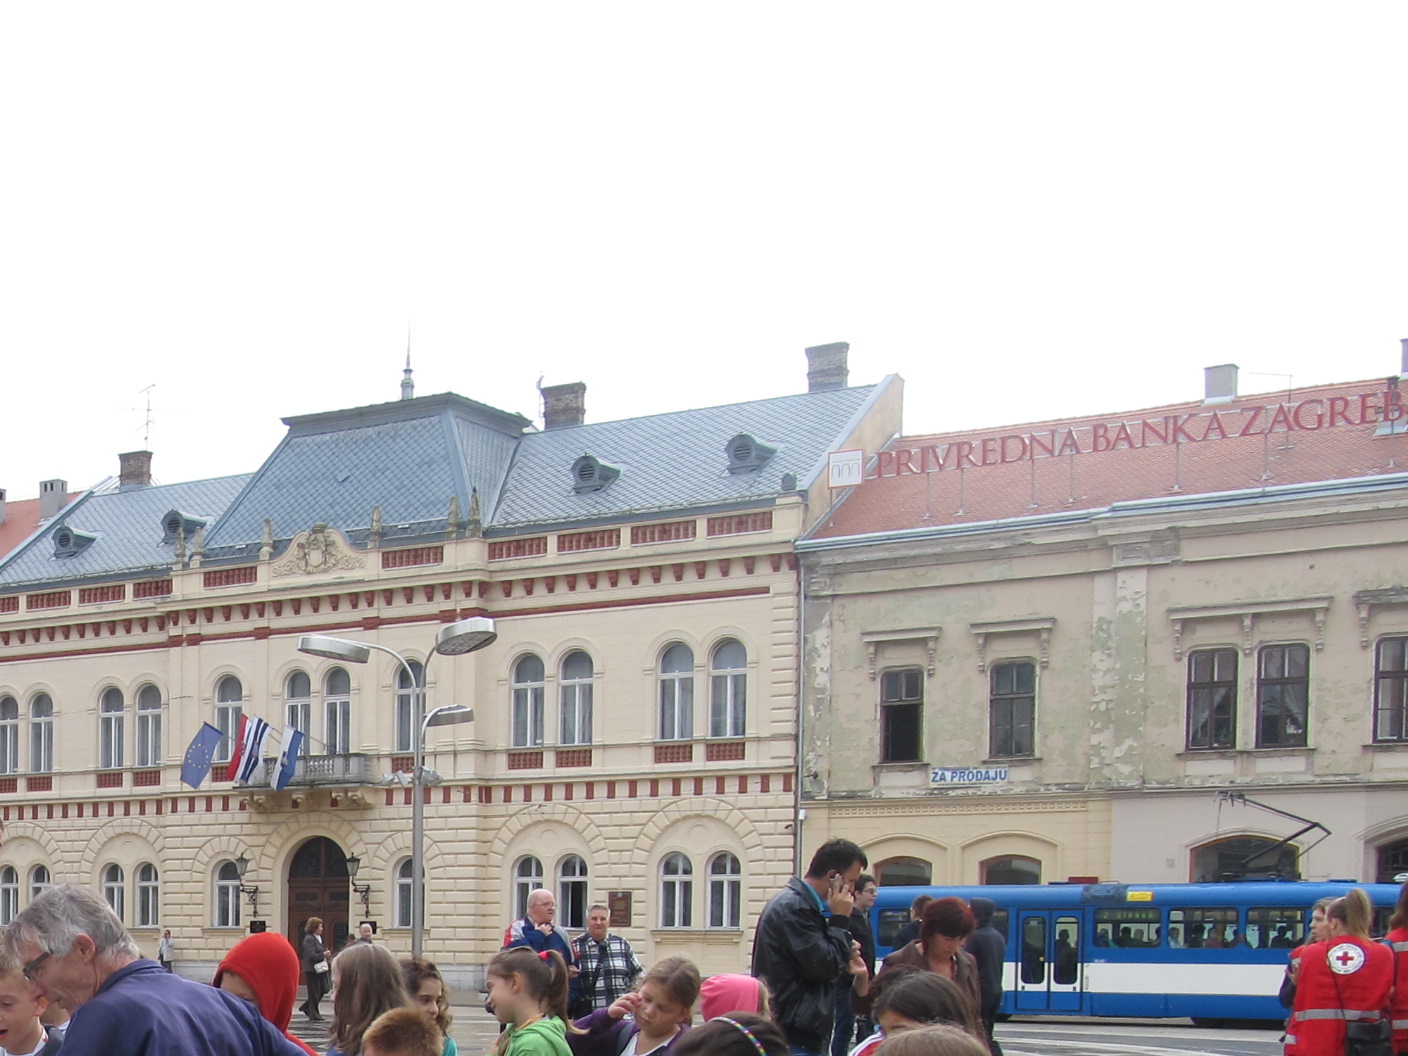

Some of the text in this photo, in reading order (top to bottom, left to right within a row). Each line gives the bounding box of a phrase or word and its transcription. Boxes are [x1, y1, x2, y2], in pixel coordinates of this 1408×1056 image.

[876, 389, 1406, 478] PRIVREDNA BANKA ZAGREB
[931, 769, 1007, 782] ZA PRODAJU
